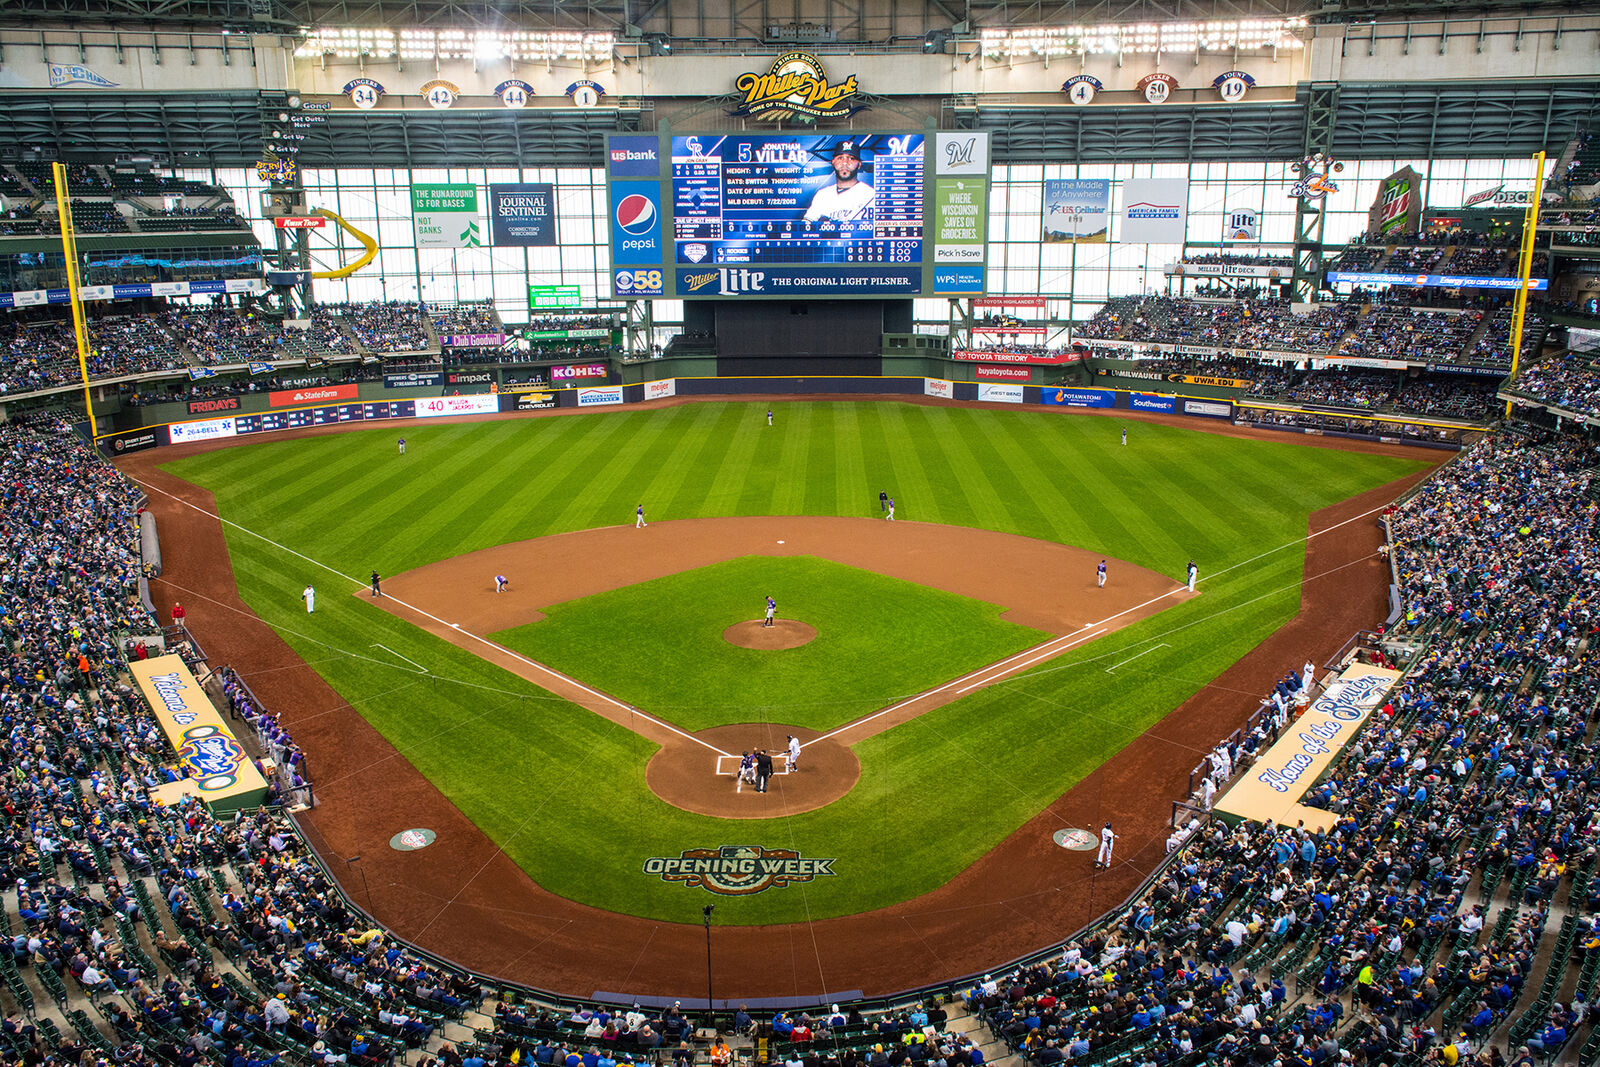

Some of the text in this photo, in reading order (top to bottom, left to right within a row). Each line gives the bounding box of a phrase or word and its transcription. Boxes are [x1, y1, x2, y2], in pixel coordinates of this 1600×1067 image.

[779, 54, 816, 66] SINCE 2001
[349, 79, 378, 89] FINGERS
[1069, 76, 1098, 85] MOLITOR
[1145, 74, 1170, 82] UECKER
[737, 72, 858, 108] Miller Park
[1076, 86, 1086, 99] 4
[1150, 83, 1164, 94] 50
[1224, 82, 1242, 97] 19
[355, 90, 373, 103] 34
[431, 91, 448, 103] 42
[506, 92, 522, 104] 44
[583, 92, 588, 104] 1
[749, 104, 765, 114] HOME
[788, 104, 822, 116] MILWAUKEE
[822, 108, 850, 117] BREWERS
[738, 143, 752, 162] 5
[756, 150, 808, 162] VILLAR
[416, 190, 474, 198] THE RUNAROUND
[949, 193, 972, 204] WHERE
[1062, 191, 1102, 200] Anywhere
[416, 199, 466, 208] IS FOR BASES
[499, 197, 547, 208] JOURNAL
[499, 206, 548, 216] SENTINEL
[862, 207, 874, 220] 2B
[942, 205, 978, 216] WISCONSIN
[418, 217, 432, 225] NOT
[944, 217, 976, 228] SAVES ON
[1231, 214, 1255, 229] Lite
[419, 226, 442, 234] BANKS
[941, 228, 978, 240] GROCERIES.
[622, 238, 655, 251] pepsi
[1222, 264, 1238, 276] Lite
[634, 270, 662, 290] 58
[684, 268, 912, 296] Miller Lite THE ORIGINAL LIGHT PILSNER.
[936, 276, 956, 284] WPS
[1337, 274, 1357, 282] Energy
[1440, 277, 1462, 286] Energy
[1489, 278, 1514, 286] depend
[454, 334, 501, 346] Club Goodwill
[1174, 344, 1187, 354] Lite
[553, 366, 606, 378] KOHL'S
[978, 368, 1028, 376] buyatoyota.com
[458, 373, 491, 384] impact
[1194, 376, 1234, 387] UWM.EDU
[190, 399, 237, 413] FRIDAYS
[428, 400, 444, 412] 40
[1134, 399, 1168, 409] Southwest
[150, 672, 198, 726] Welcome to
[1258, 675, 1396, 792] Home of the Brewers
[646, 858, 830, 874] OPENING WEEK
